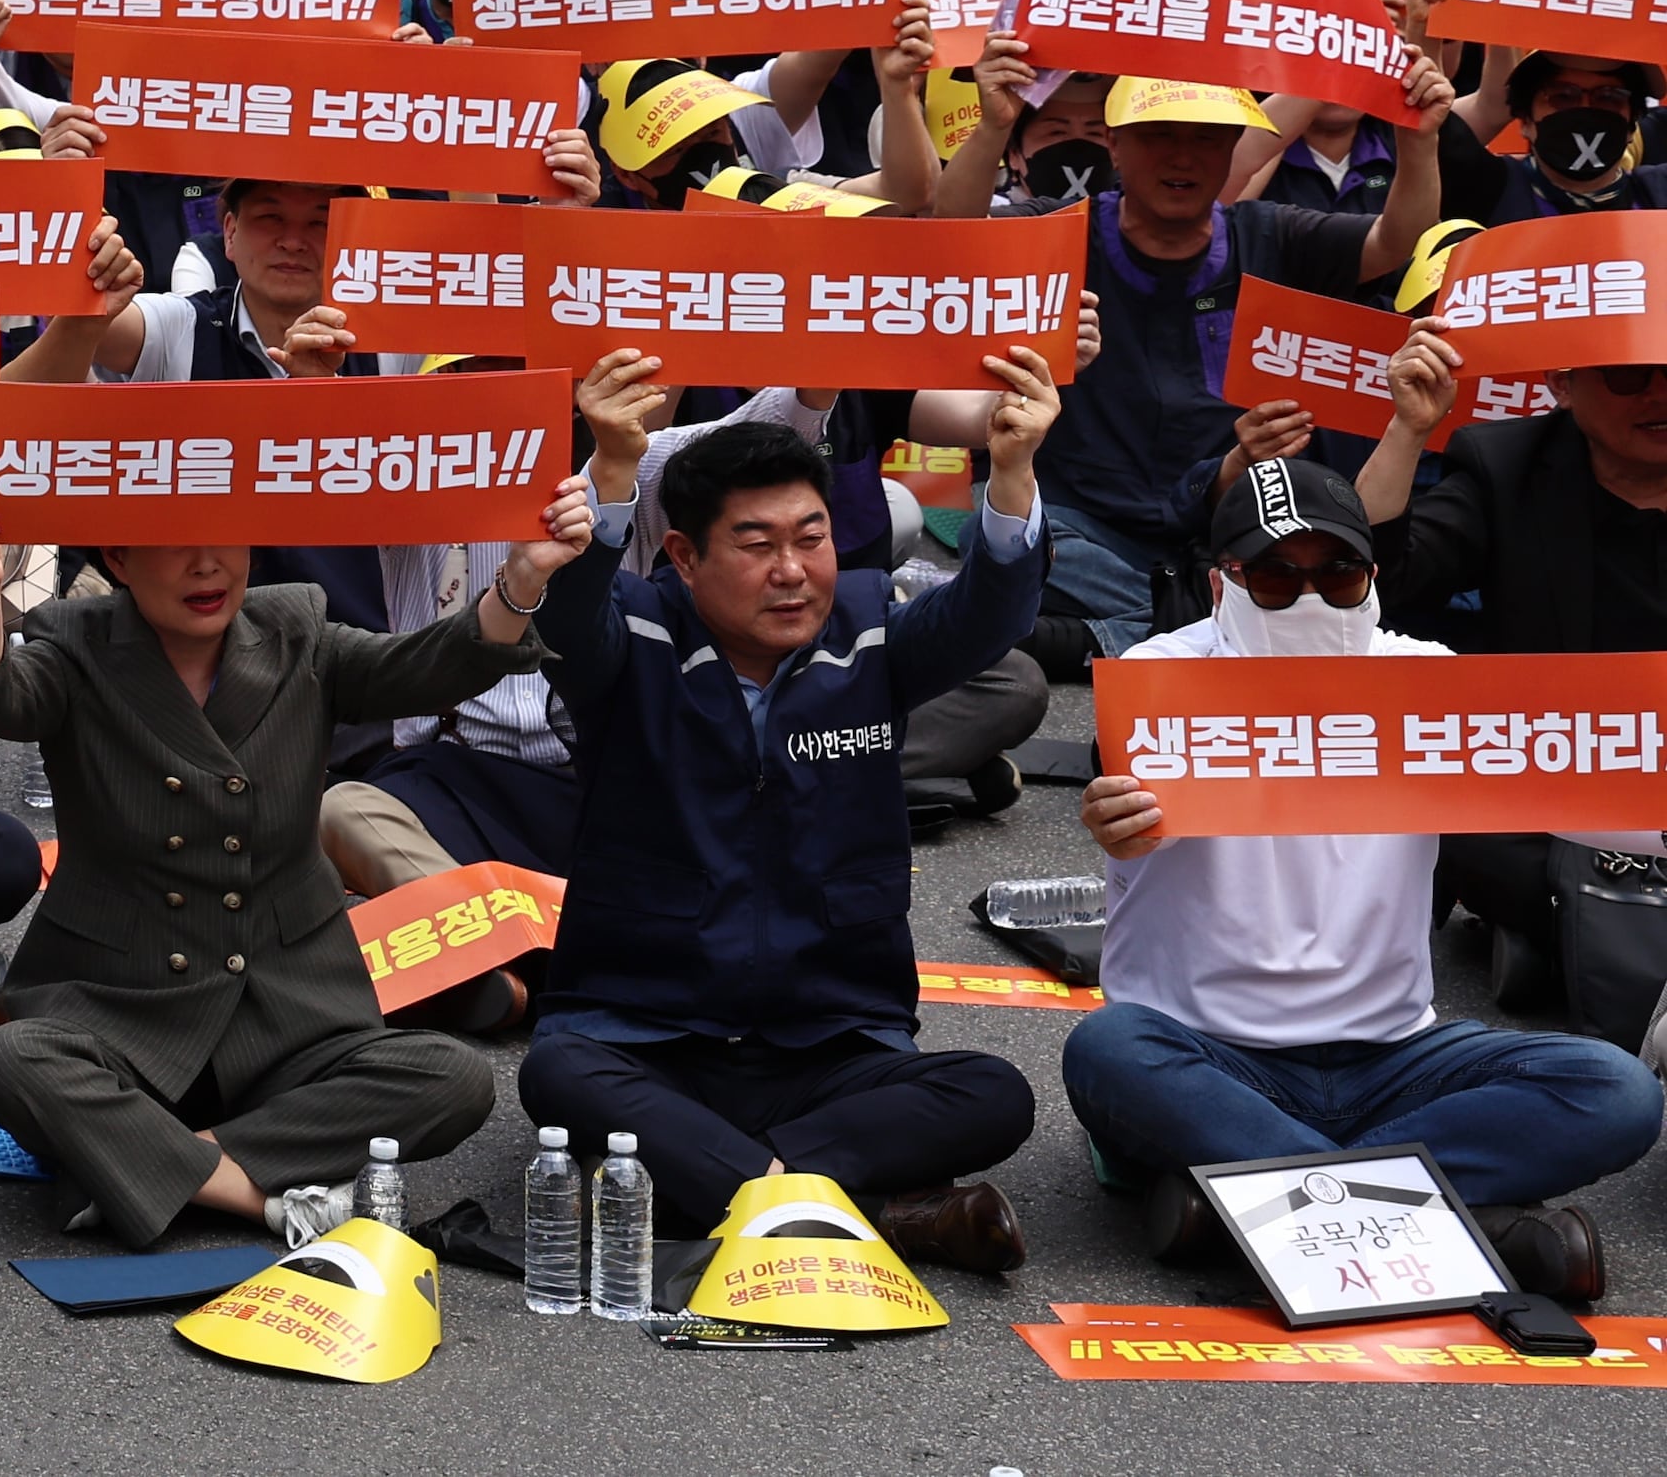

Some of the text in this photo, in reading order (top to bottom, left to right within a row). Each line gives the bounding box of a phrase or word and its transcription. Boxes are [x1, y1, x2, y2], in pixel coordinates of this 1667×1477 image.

[89, 75, 561, 154] 생존권을 보장하라!!
[548, 265, 1069, 336] 생존권을 보장하라!!
[254, 428, 546, 494] 보장하라!!
[786, 721, 896, 763] (사)한국마트협
[1123, 714, 1379, 787] 생존권을
[359, 887, 546, 983] 고용정책
[917, 972, 1071, 1000] 용정책
[1287, 1212, 1435, 1259] 골목상권
[723, 1255, 925, 1298] 더 이상은 못버틴다!
[725, 1277, 932, 1317] 생존권을 보장하라!!
[232, 1283, 379, 1355] 이상은 못버틴다!
[254, 1311, 360, 1370] 보장하라!!
